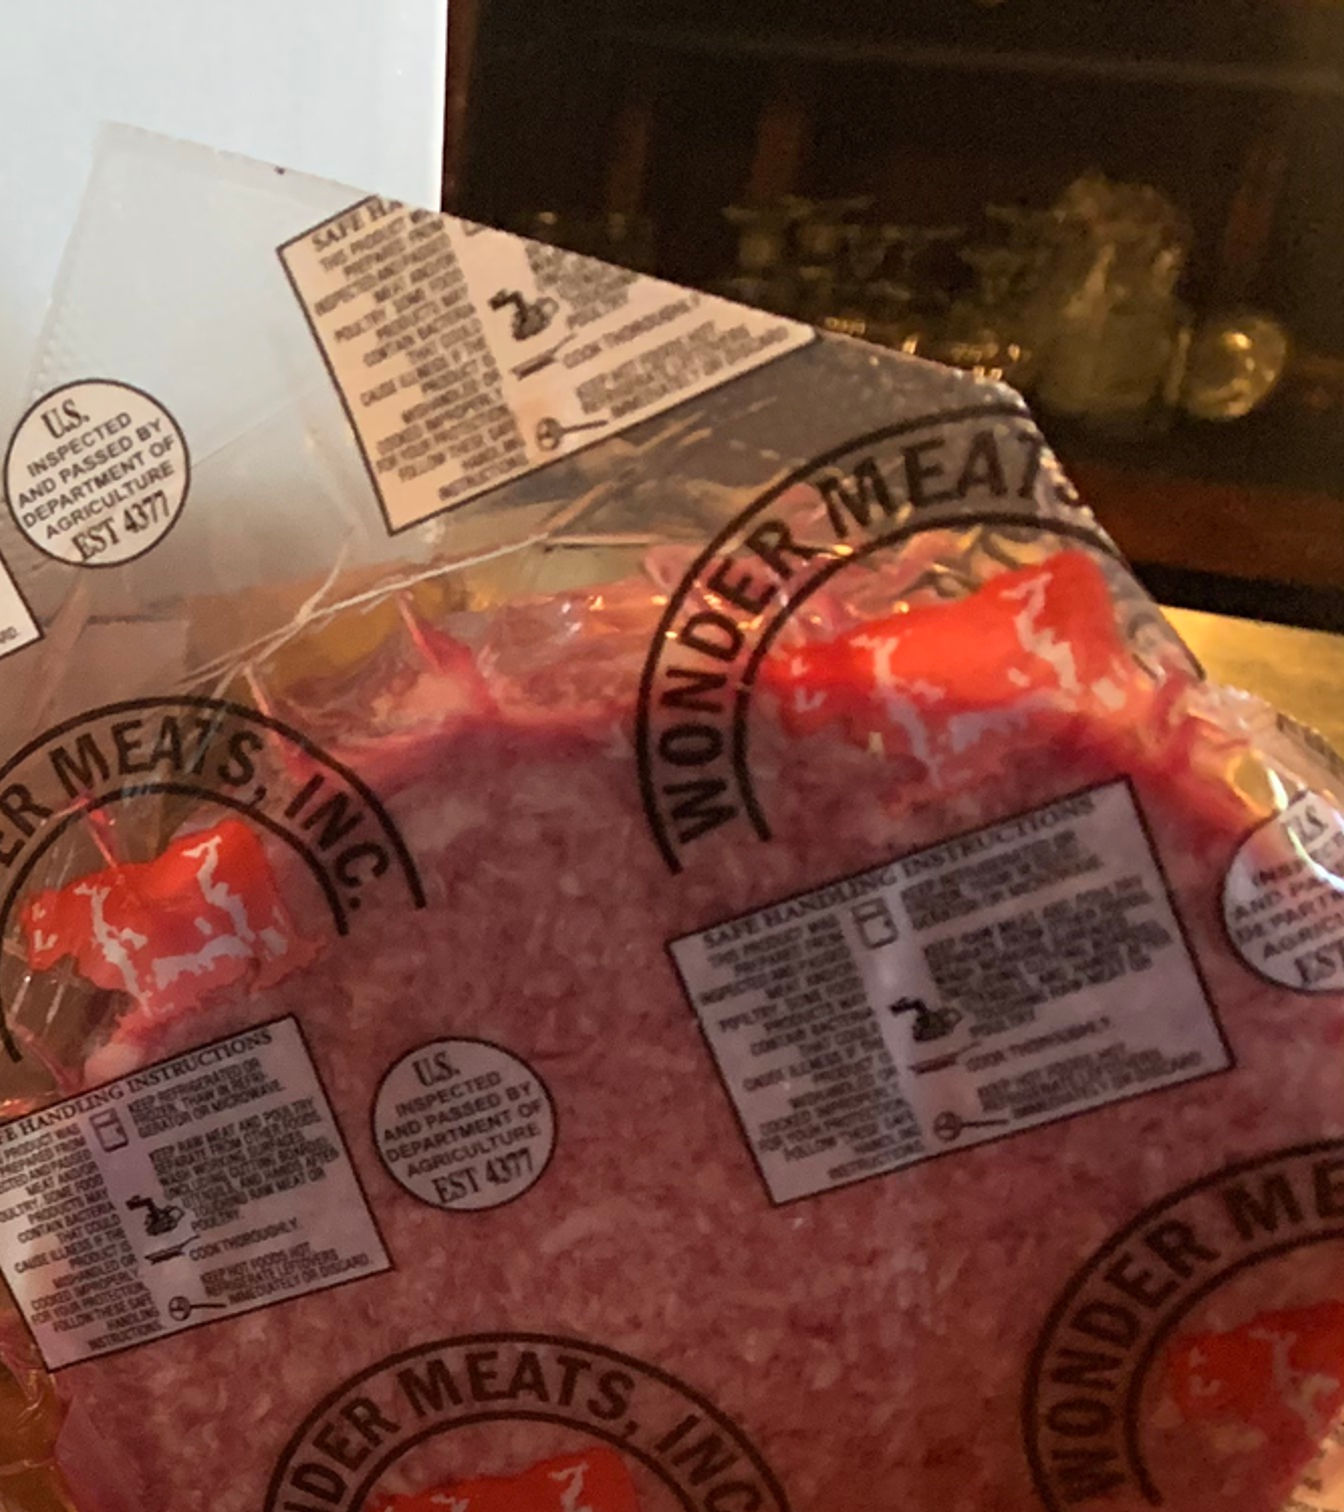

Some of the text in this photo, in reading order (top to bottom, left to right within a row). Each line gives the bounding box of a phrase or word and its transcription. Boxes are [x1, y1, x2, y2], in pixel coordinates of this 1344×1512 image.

[26, 412, 132, 477] INSPECTED
[40, 398, 90, 439] U.S.
[17, 418, 162, 508] AND PASSED BY
[22, 434, 175, 529] DEPARTMENT OF
[46, 460, 175, 539] AGRICULTURE
[71, 489, 170, 562] EST 4377
[657, 517, 814, 845] WONDER
[814, 427, 1052, 538] MEAT
[284, 774, 391, 910] INC.
[17, 1084, 125, 1136] HANDLING
[126, 1026, 273, 1094] INSTRUCTIONS
[395, 1071, 502, 1118] INSPECTED
[412, 1051, 460, 1087] U.S.
[384, 1081, 532, 1143] AND PASSED BY
[386, 1099, 542, 1163] DEPARTMENT OF
[407, 1122, 541, 1178] AGRICULTURE
[432, 1148, 533, 1203] EST 4377
[396, 1350, 640, 1438] MEATS,
[1045, 1218, 1221, 1500] WONDER
